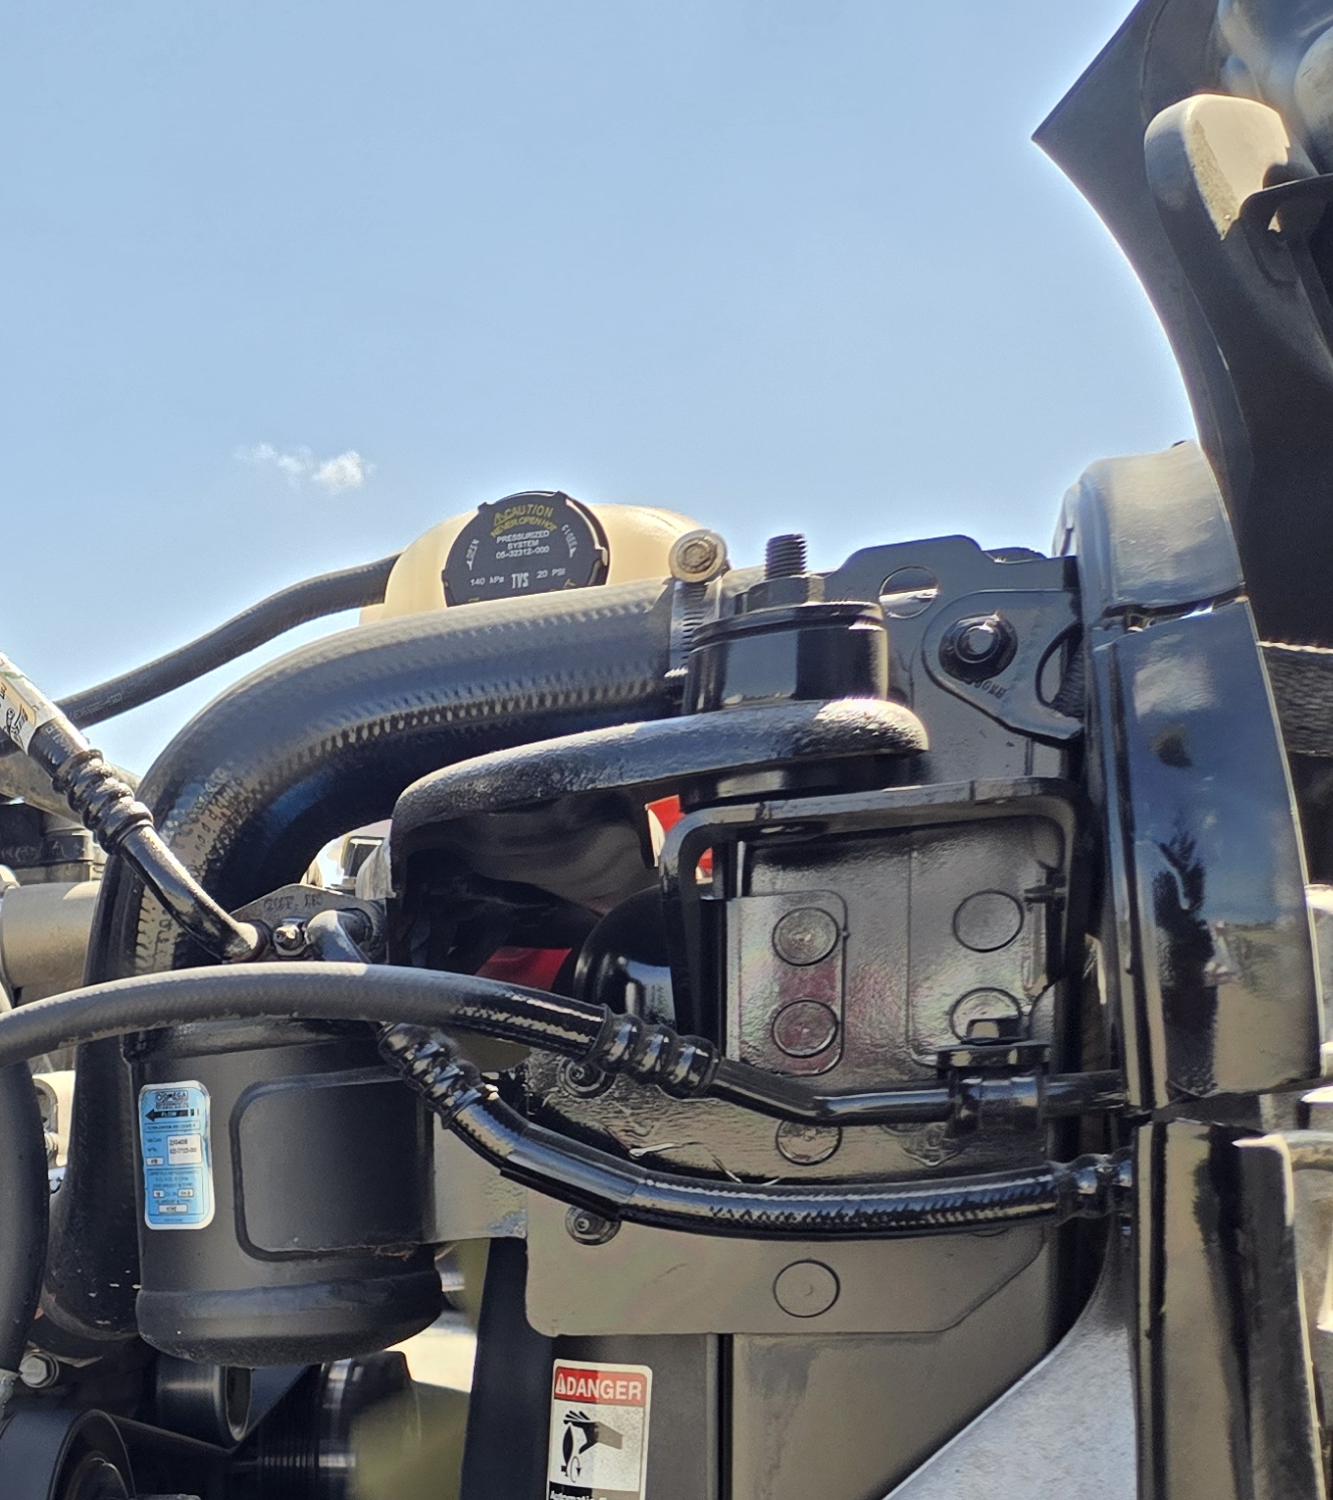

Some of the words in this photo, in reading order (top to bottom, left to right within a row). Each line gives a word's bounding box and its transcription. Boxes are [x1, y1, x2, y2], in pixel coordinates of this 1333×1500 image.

[504, 503, 554, 518] CAUTION
[490, 517, 518, 538] NEVER
[517, 515, 542, 525] OPEN
[541, 518, 558, 532] HOT
[496, 529, 550, 543] PRESSURIZED
[507, 539, 540, 551] SYSTEM
[510, 571, 530, 590] TVS
[536, 569, 548, 580] 20
[551, 567, 566, 577] PSI
[469, 577, 486, 587] 140
[566, 1376, 642, 1401] DANGER
